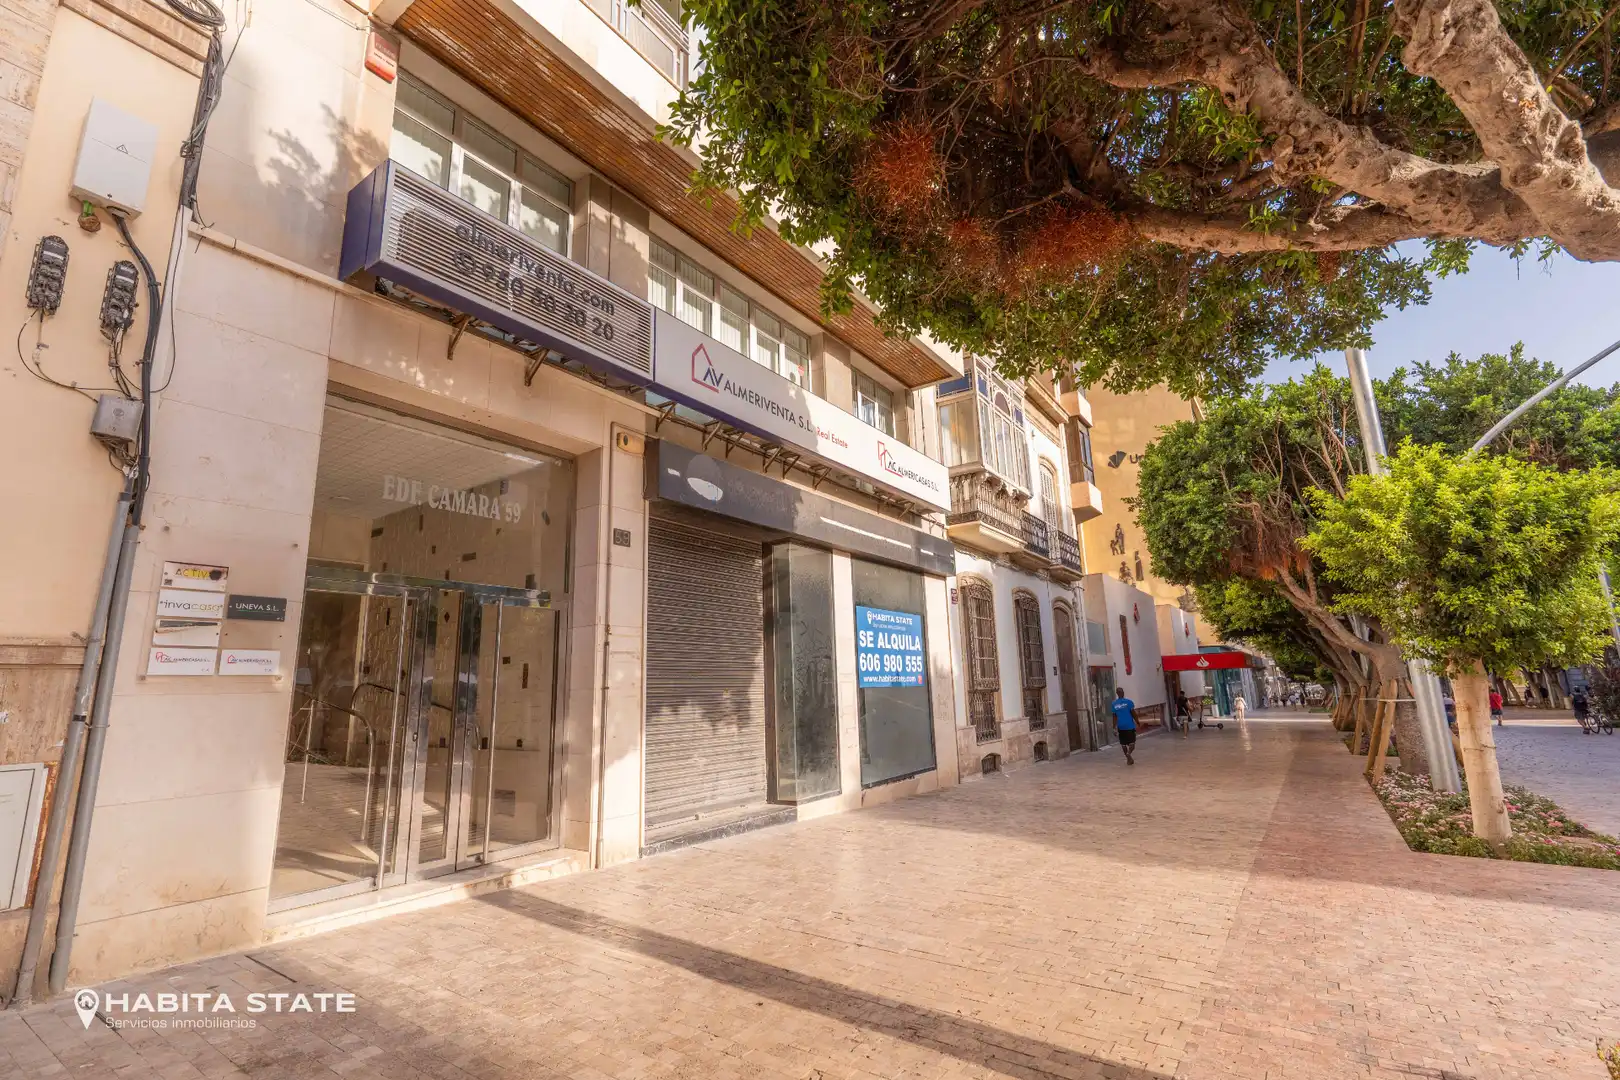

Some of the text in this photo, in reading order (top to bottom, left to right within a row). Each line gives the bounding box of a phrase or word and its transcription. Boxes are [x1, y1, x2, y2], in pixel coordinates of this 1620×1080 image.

[456, 222, 616, 316] almeriventa.com
[483, 262, 614, 341] 950 50 20 20
[724, 380, 796, 425] ALMERIVENTA
[798, 415, 814, 433] S.L.
[816, 426, 831, 441] Real
[831, 433, 849, 449] Estate
[898, 466, 931, 488] ALMERICASAS
[382, 474, 522, 523] EDF. CAMARA 59
[615, 531, 630, 545] 59
[164, 600, 220, 612] invacasa
[235, 602, 280, 612] UNEVA S.L.
[872, 612, 913, 626] HABITA STATE
[859, 629, 922, 651] SE ALQUILA
[860, 652, 923, 673] 606 980 555
[863, 675, 917, 683] www.habitastate.com
